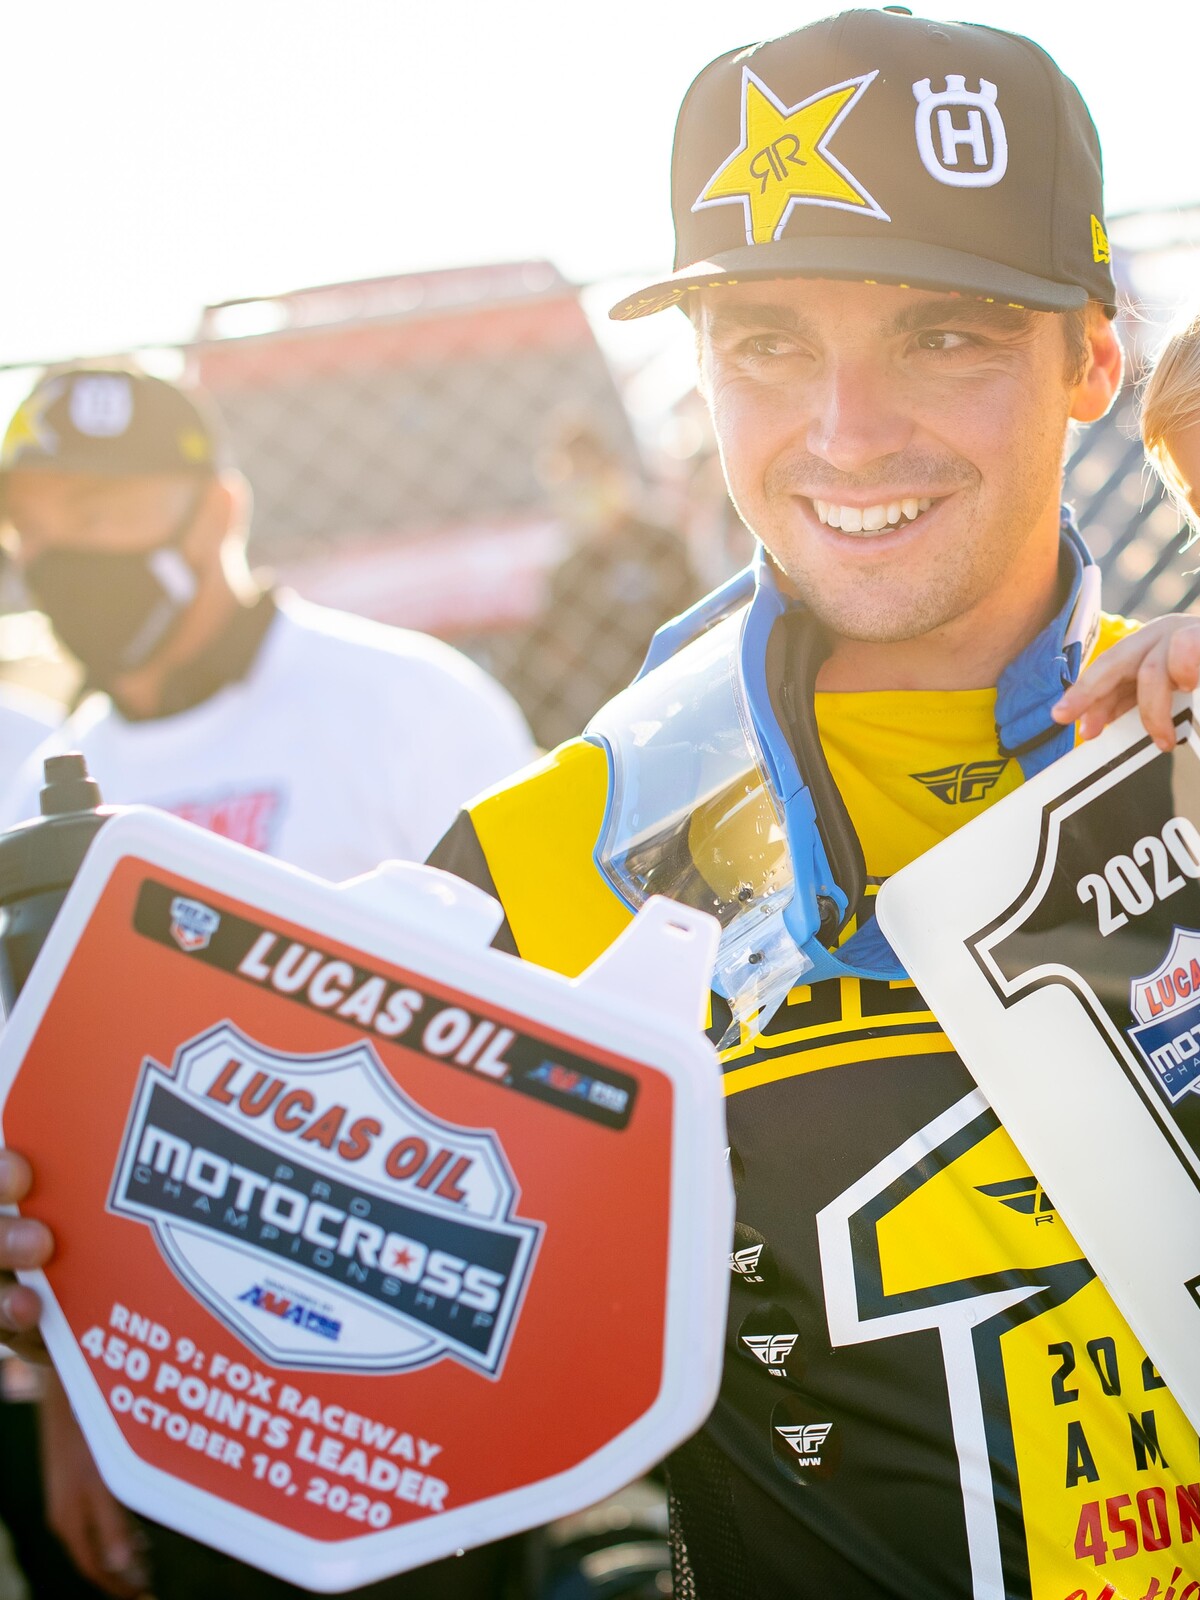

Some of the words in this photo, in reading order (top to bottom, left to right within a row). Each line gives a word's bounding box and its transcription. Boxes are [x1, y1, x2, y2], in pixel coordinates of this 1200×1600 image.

[238, 931, 424, 1036] LUCAS
[206, 1058, 382, 1162] LUCAS
[134, 1165, 494, 1328] CHAMPIONSHIP
[138, 1123, 505, 1313] MOTOCROSS
[274, 1163, 372, 1217] PRO
[80, 1325, 150, 1381] 450
[154, 1362, 293, 1449] POINTS
[295, 1428, 449, 1512] LEADER
[109, 1302, 170, 1351] RND
[176, 1337, 204, 1370] 9:
[209, 1353, 275, 1403] FOX
[277, 1384, 443, 1467] RACEWAY
[109, 1385, 246, 1471] OCTOBER
[252, 1454, 298, 1496] 10,
[305, 1477, 392, 1529] 2020
[798, 1457, 822, 1467] WW
